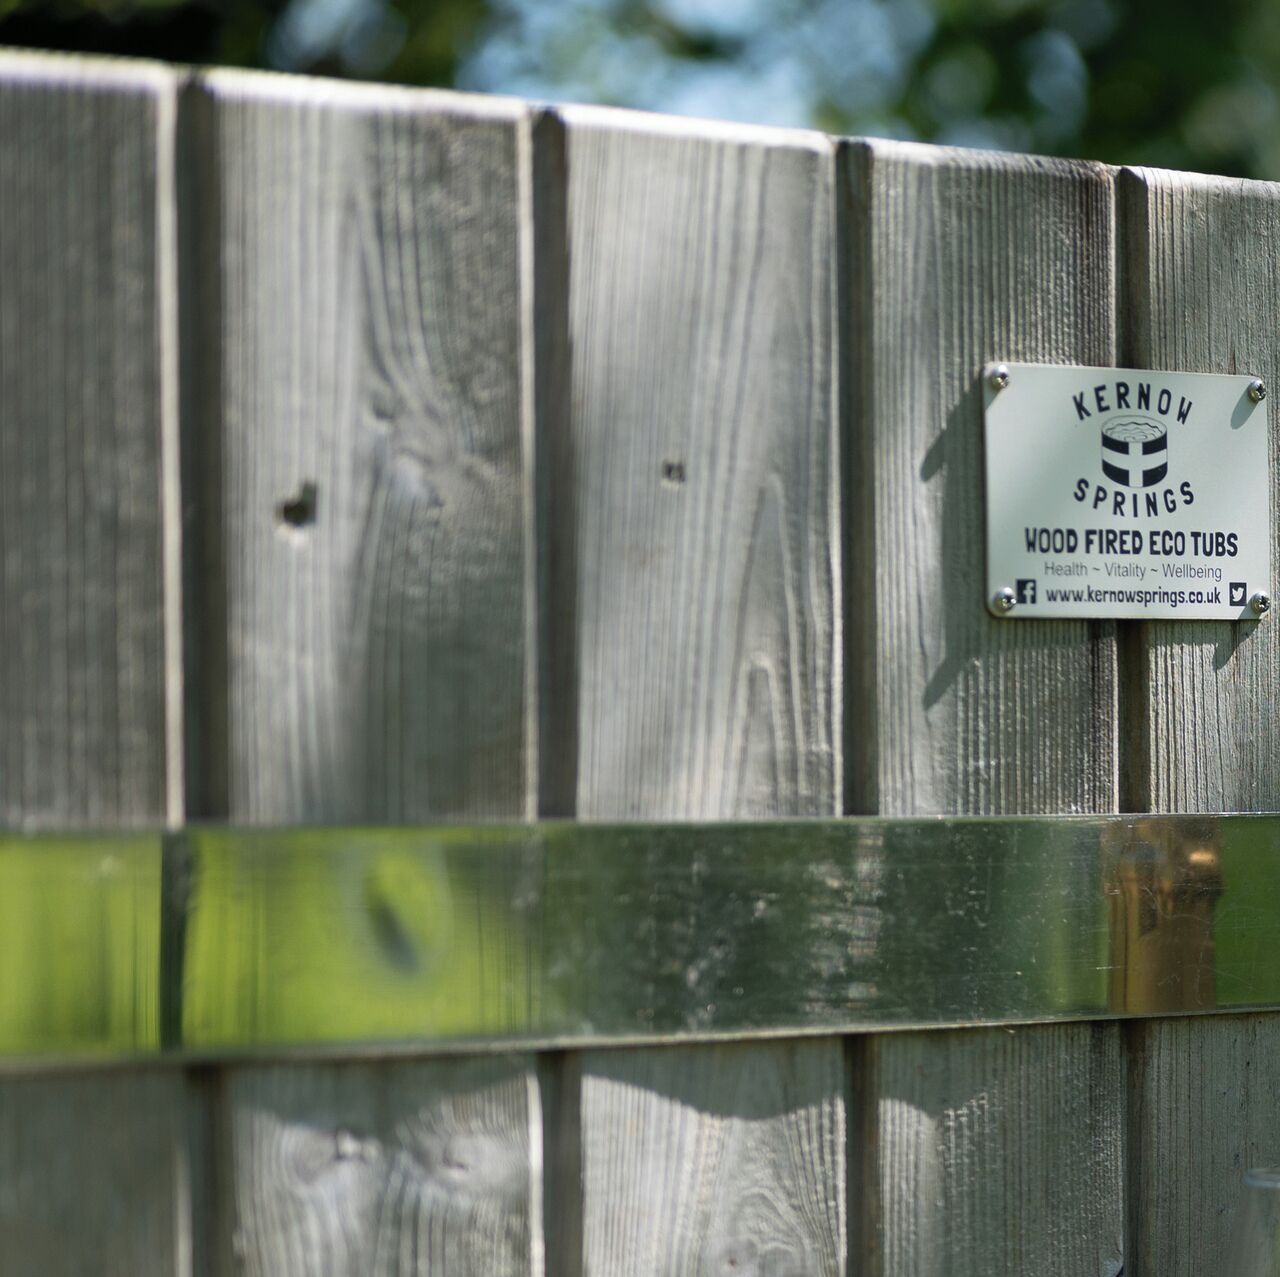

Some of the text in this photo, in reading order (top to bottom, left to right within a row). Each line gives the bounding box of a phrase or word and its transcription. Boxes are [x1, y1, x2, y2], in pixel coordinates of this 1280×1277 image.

[1073, 381, 1192, 425] KERNOW
[1073, 478, 1194, 518] SPRINGS
[1025, 527, 1238, 557] WOOD FIRED ECO TUBS
[1044, 561, 1088, 577] Health
[1105, 562, 1146, 580] Vitality
[1162, 563, 1222, 582] Wellbeing
[1046, 585, 1222, 607] www.kernowsprings.co.uk
